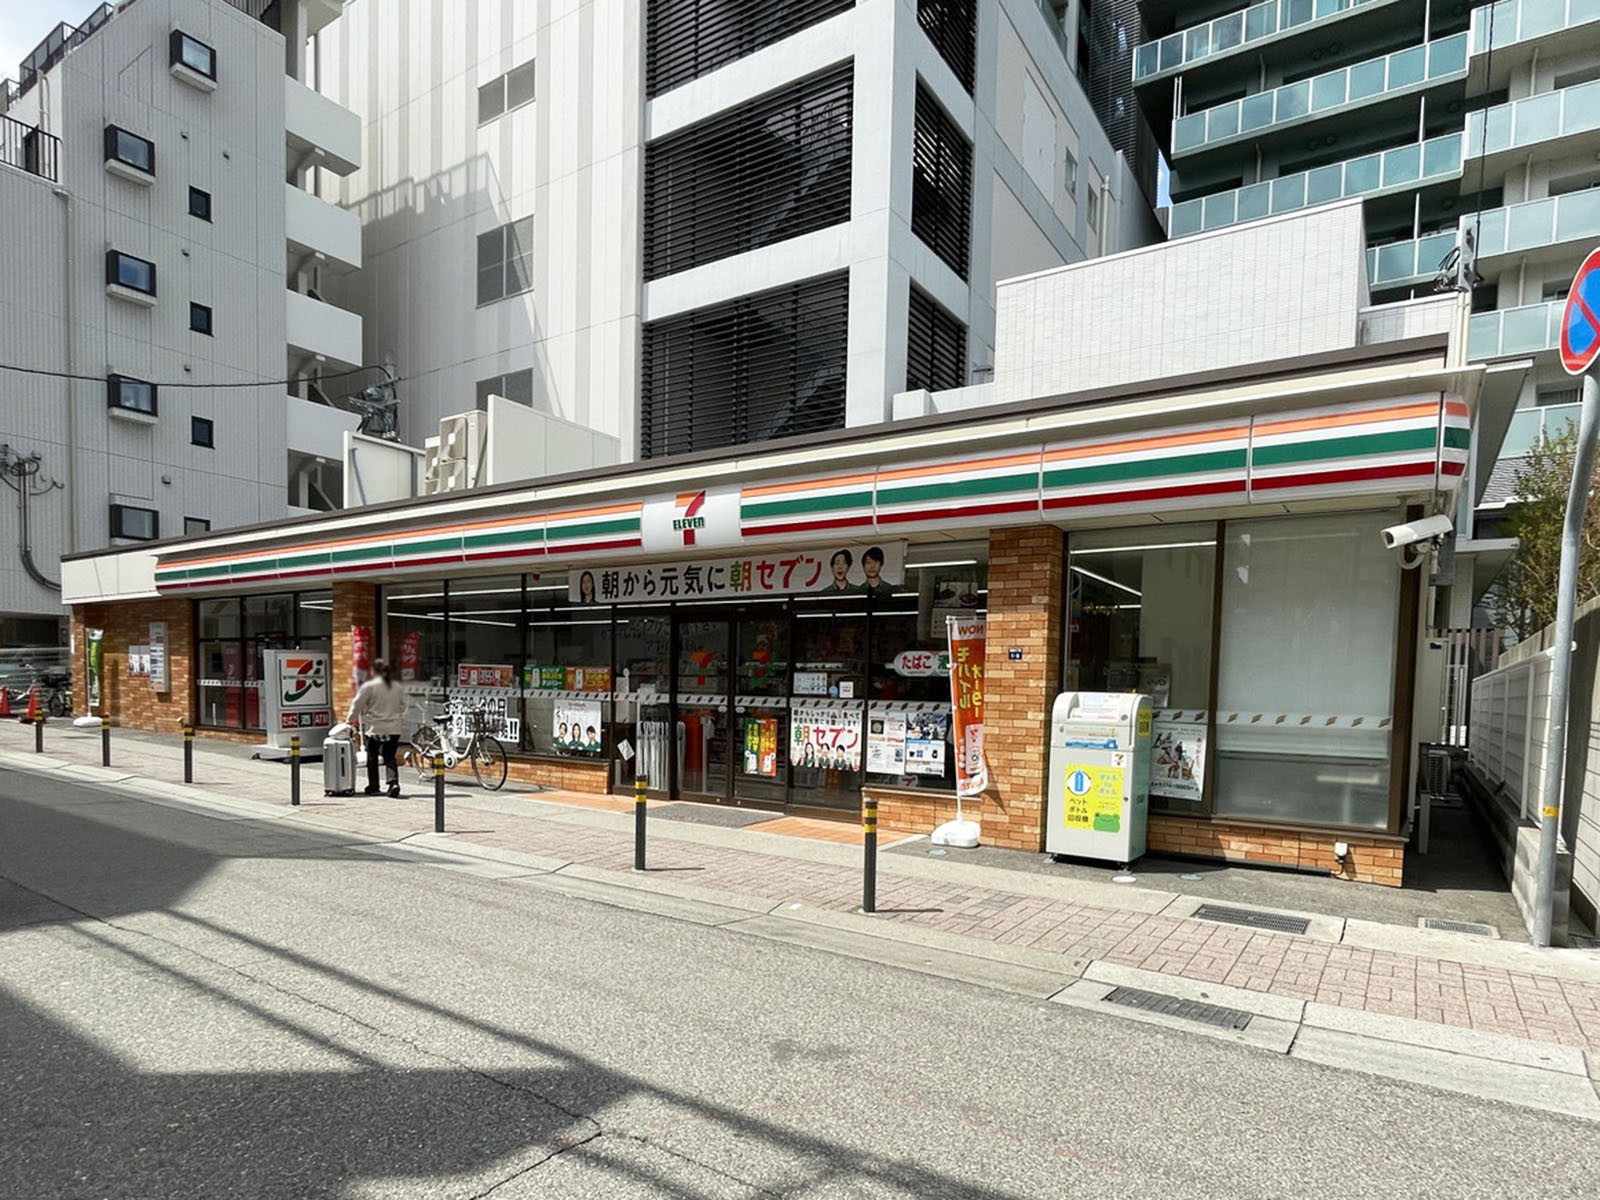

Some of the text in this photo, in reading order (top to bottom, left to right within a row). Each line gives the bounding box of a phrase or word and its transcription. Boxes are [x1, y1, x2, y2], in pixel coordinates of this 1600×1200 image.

[601, 554, 822, 599] 朝から元気に朝セブン
[902, 655, 932, 670] たばこ
[794, 725, 858, 749] 朝セブン
[1069, 798, 1088, 806] ペット
[1069, 806, 1088, 814] ボトル
